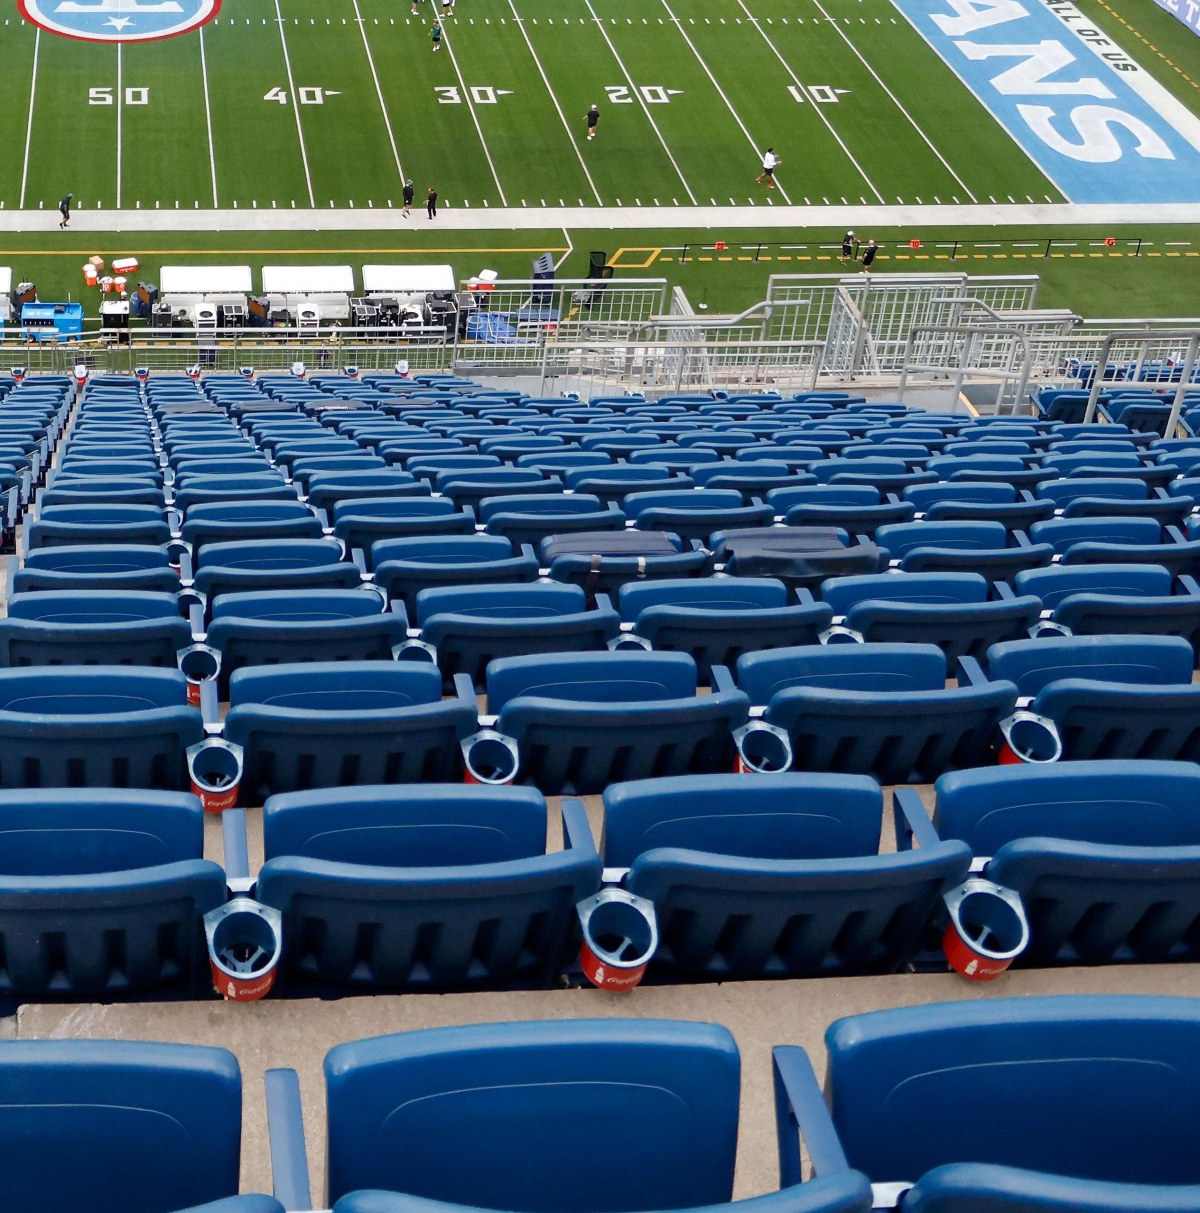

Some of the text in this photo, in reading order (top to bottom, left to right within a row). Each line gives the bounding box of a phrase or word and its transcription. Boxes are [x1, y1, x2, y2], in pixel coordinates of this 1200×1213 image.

[1076, 28, 1111, 48] OF
[1100, 54, 1138, 73] US
[88, 87, 150, 106] 50
[262, 86, 325, 105] 40
[433, 86, 499, 104] 30
[603, 86, 671, 104] 20
[786, 85, 842, 104] 10
